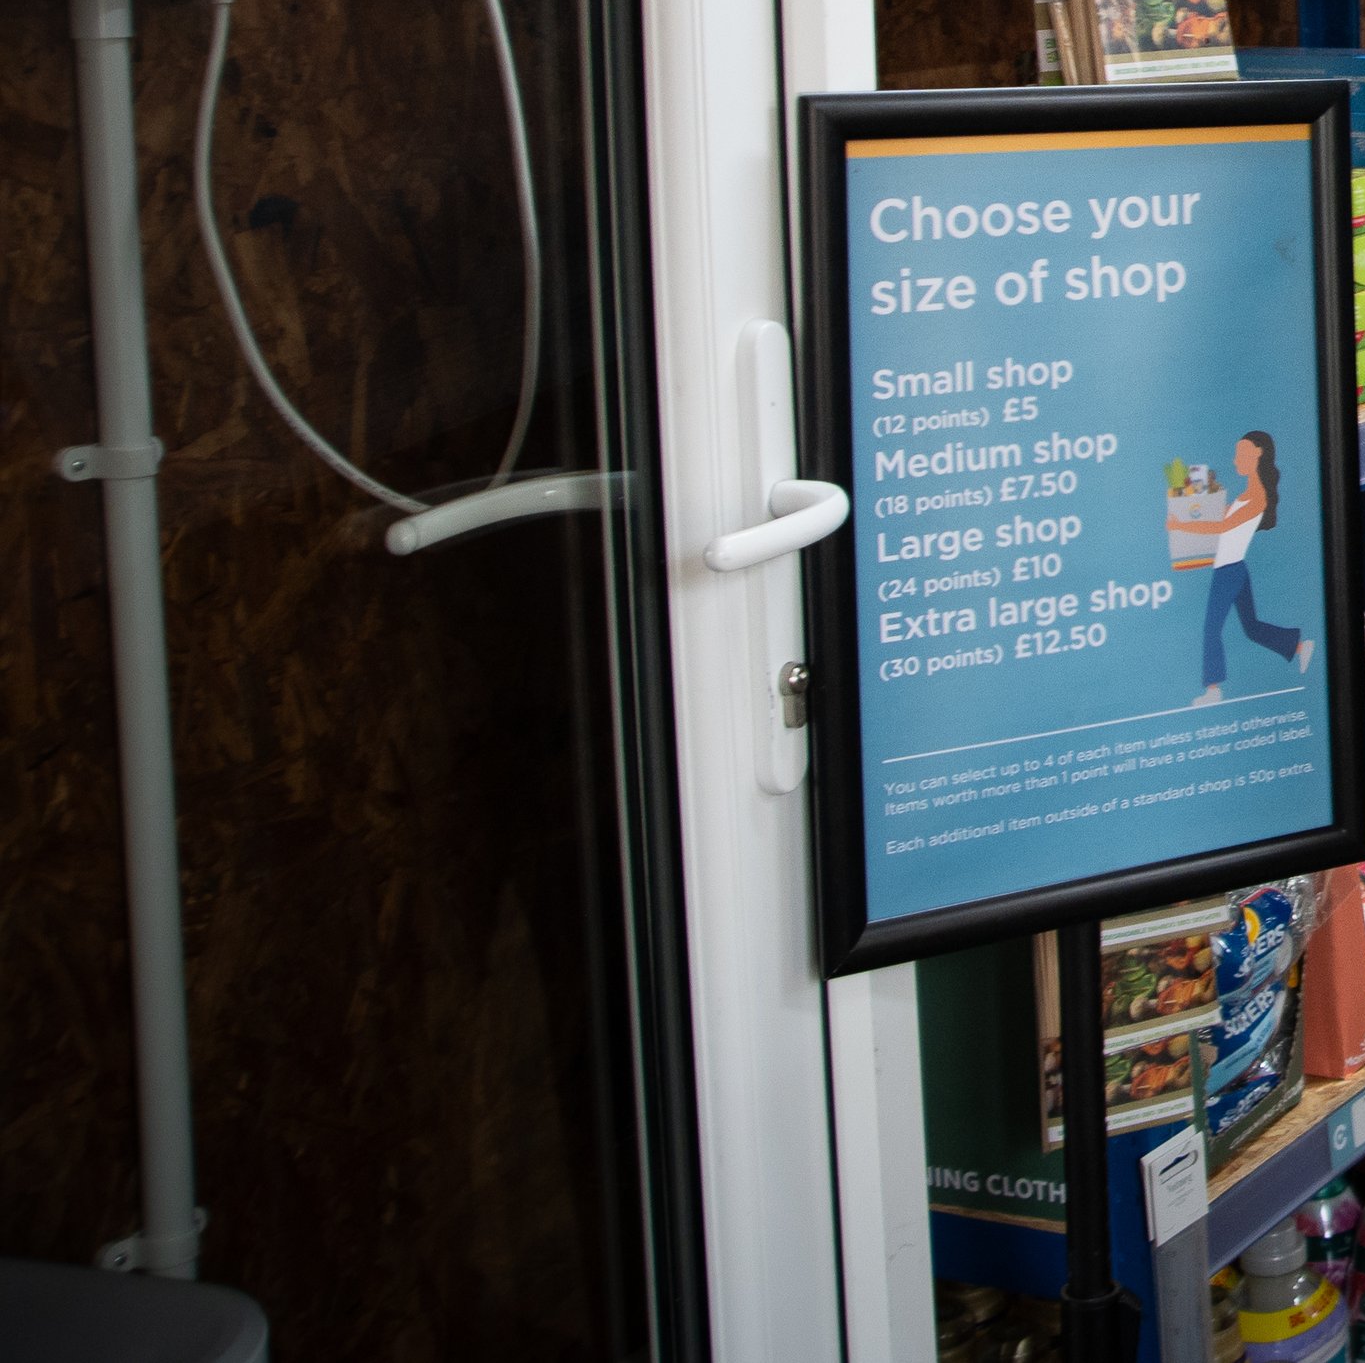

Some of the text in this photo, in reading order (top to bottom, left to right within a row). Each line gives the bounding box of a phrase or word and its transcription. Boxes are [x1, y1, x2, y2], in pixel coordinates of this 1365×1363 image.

[871, 192, 1201, 243] Choose your
[871, 255, 1187, 315] size of shop
[872, 357, 1073, 400] Small shop
[873, 396, 1039, 437] (12 points) £5
[874, 432, 1118, 481] Medium shop
[874, 470, 1078, 518] (18 points) £7.50
[877, 514, 1082, 563] Large shop
[878, 553, 1062, 602] (24 points) £10
[879, 579, 1173, 644] Extra large shop
[879, 623, 1107, 681] (30 points) £12.50
[884, 708, 1309, 797] You can select up to 4 of each item unless stated otherwise.
[884, 799, 928, 817] Items
[932, 788, 978, 808] worth
[981, 782, 1022, 798] more
[1025, 774, 1058, 791] than
[1061, 771, 1068, 784] 1
[1070, 765, 1110, 784] point
[1112, 757, 1137, 774] will
[1139, 752, 1174, 769] have
[1175, 751, 1186, 763] a
[1188, 741, 1232, 761] colour
[1234, 731, 1276, 751] coded
[886, 761, 1315, 855] Each additional item outside of a standard shop is 50p extra.
[986, 1173, 1067, 1205] CLOTH
